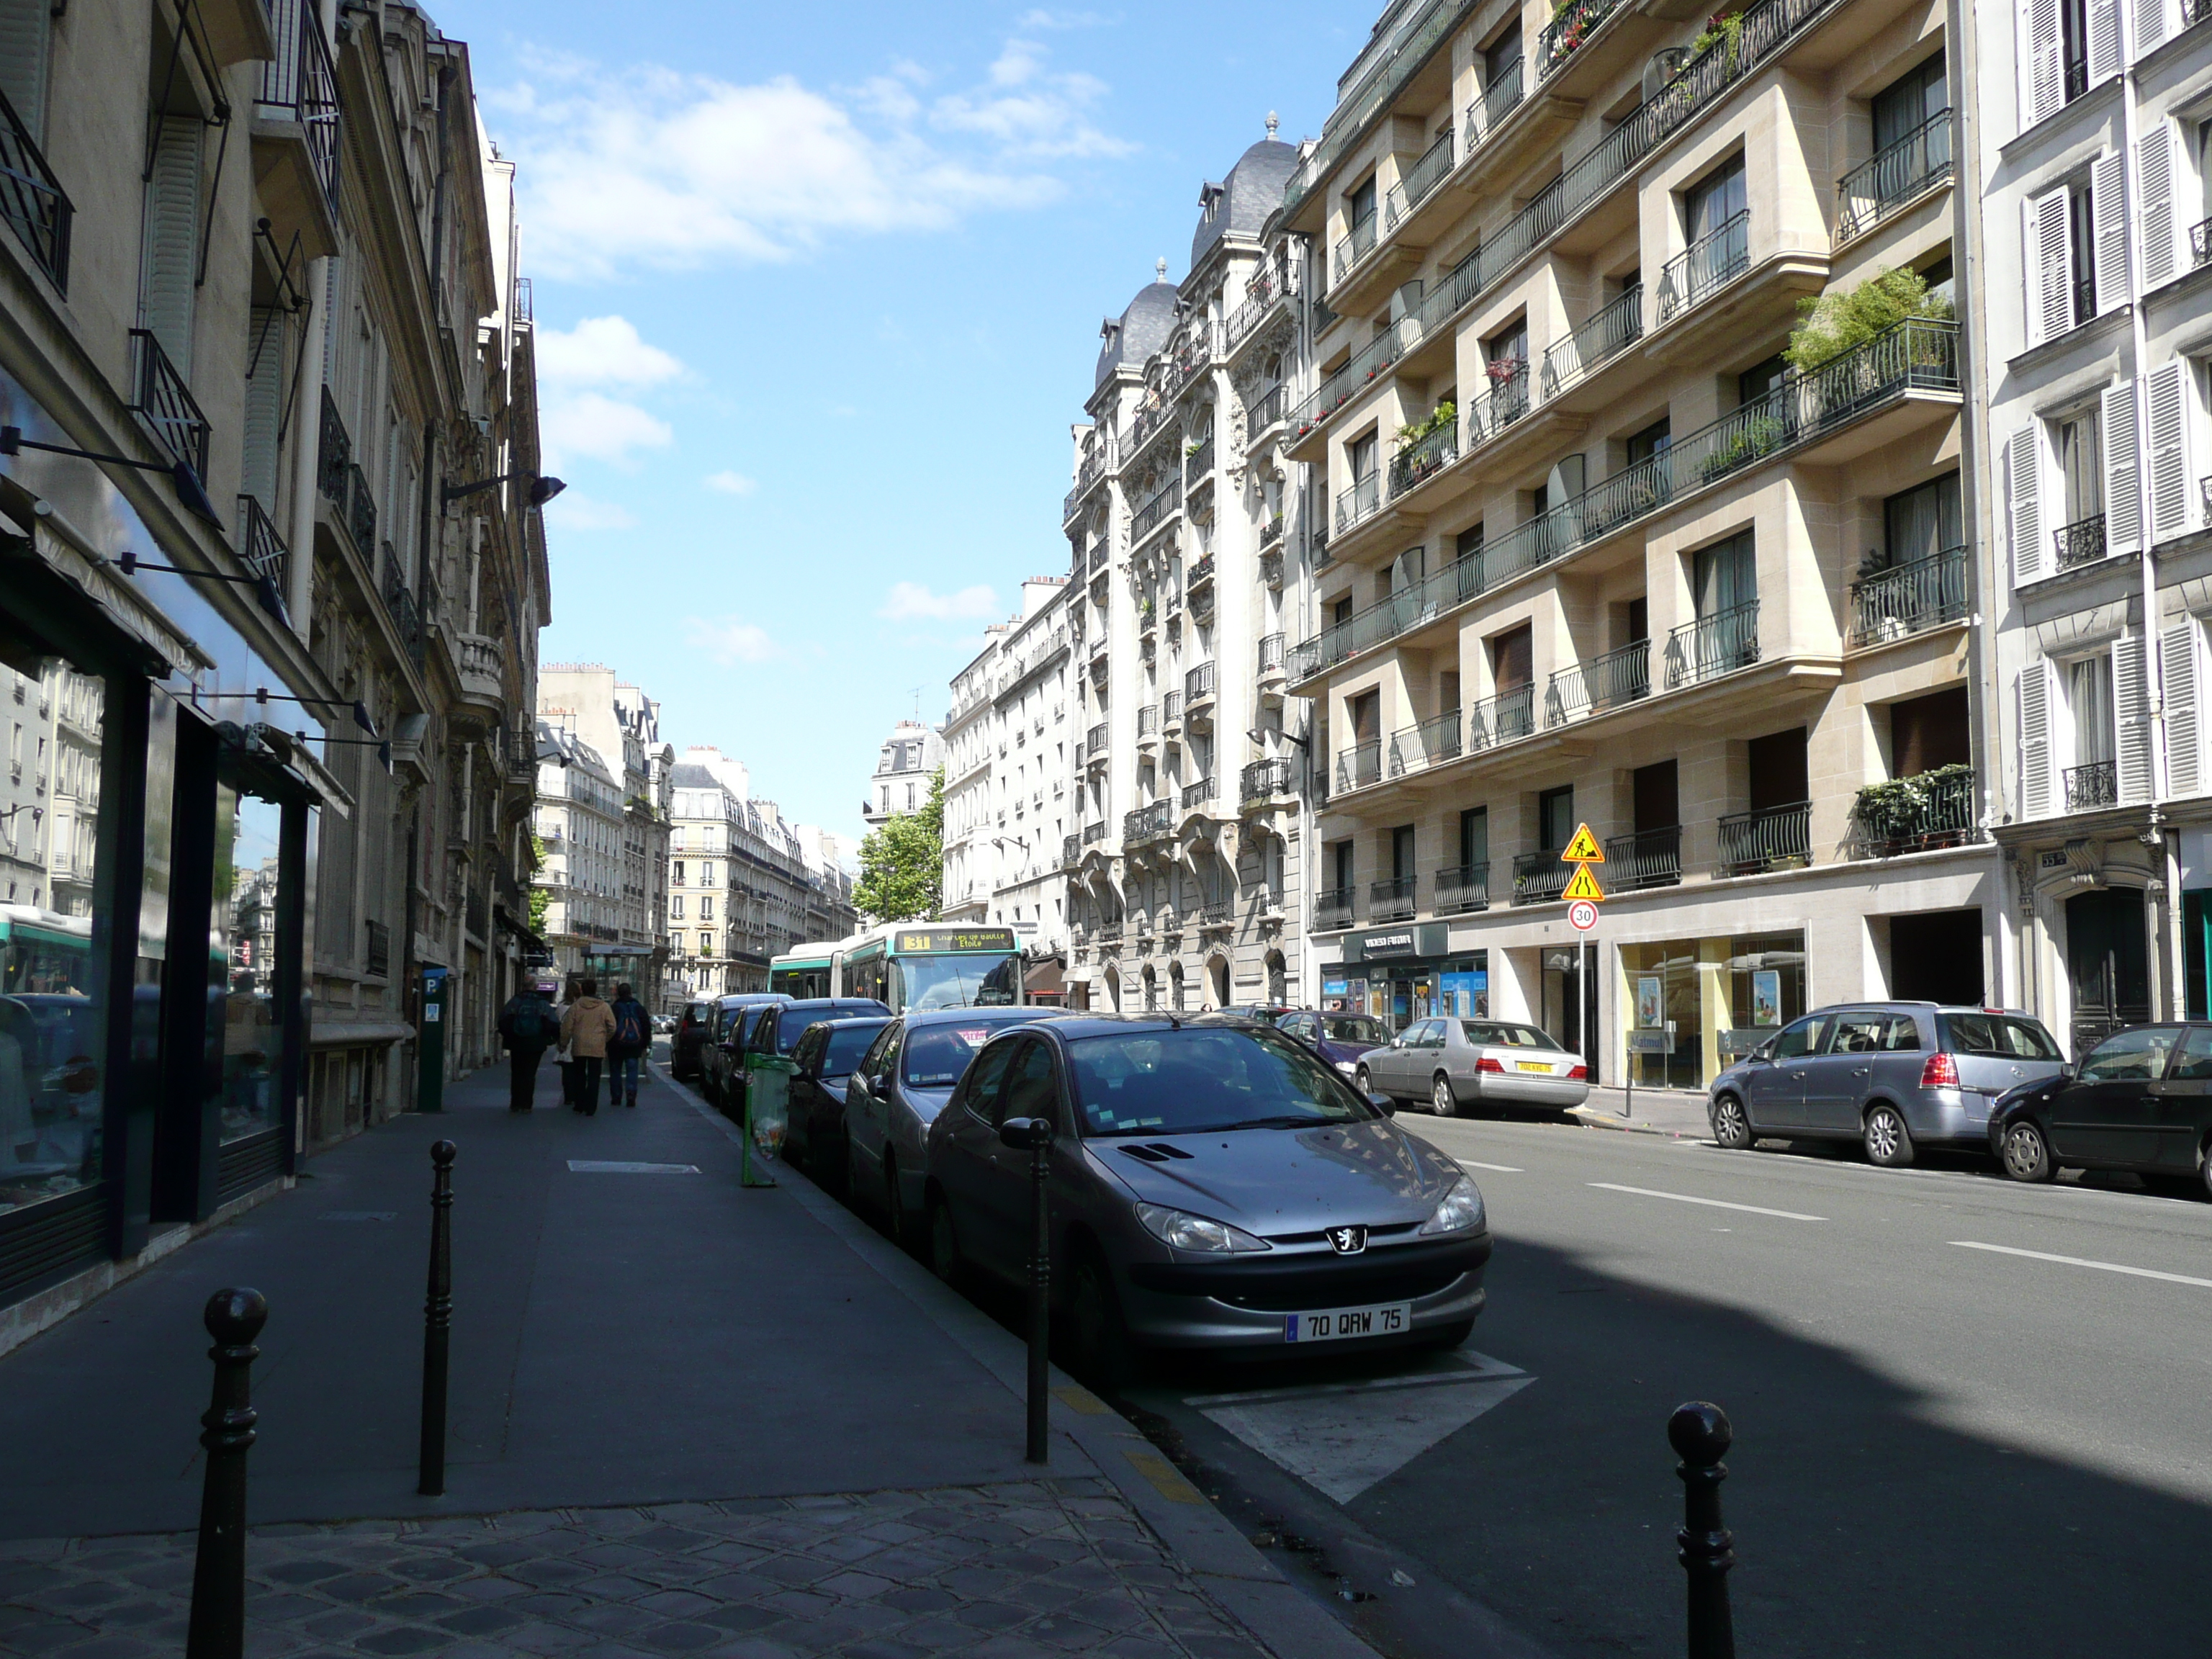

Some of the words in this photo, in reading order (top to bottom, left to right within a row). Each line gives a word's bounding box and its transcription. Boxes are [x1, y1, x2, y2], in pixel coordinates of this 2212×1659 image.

[1576, 910, 1591, 921] 30
[909, 936, 926, 948] 31
[1364, 937, 1387, 948] VIDEO
[1388, 935, 1411, 945] FUTUR
[427, 979, 436, 992] P
[1308, 1316, 1331, 1337] 70
[1339, 1312, 1372, 1334] QRW
[1380, 1308, 1402, 1330] 75
